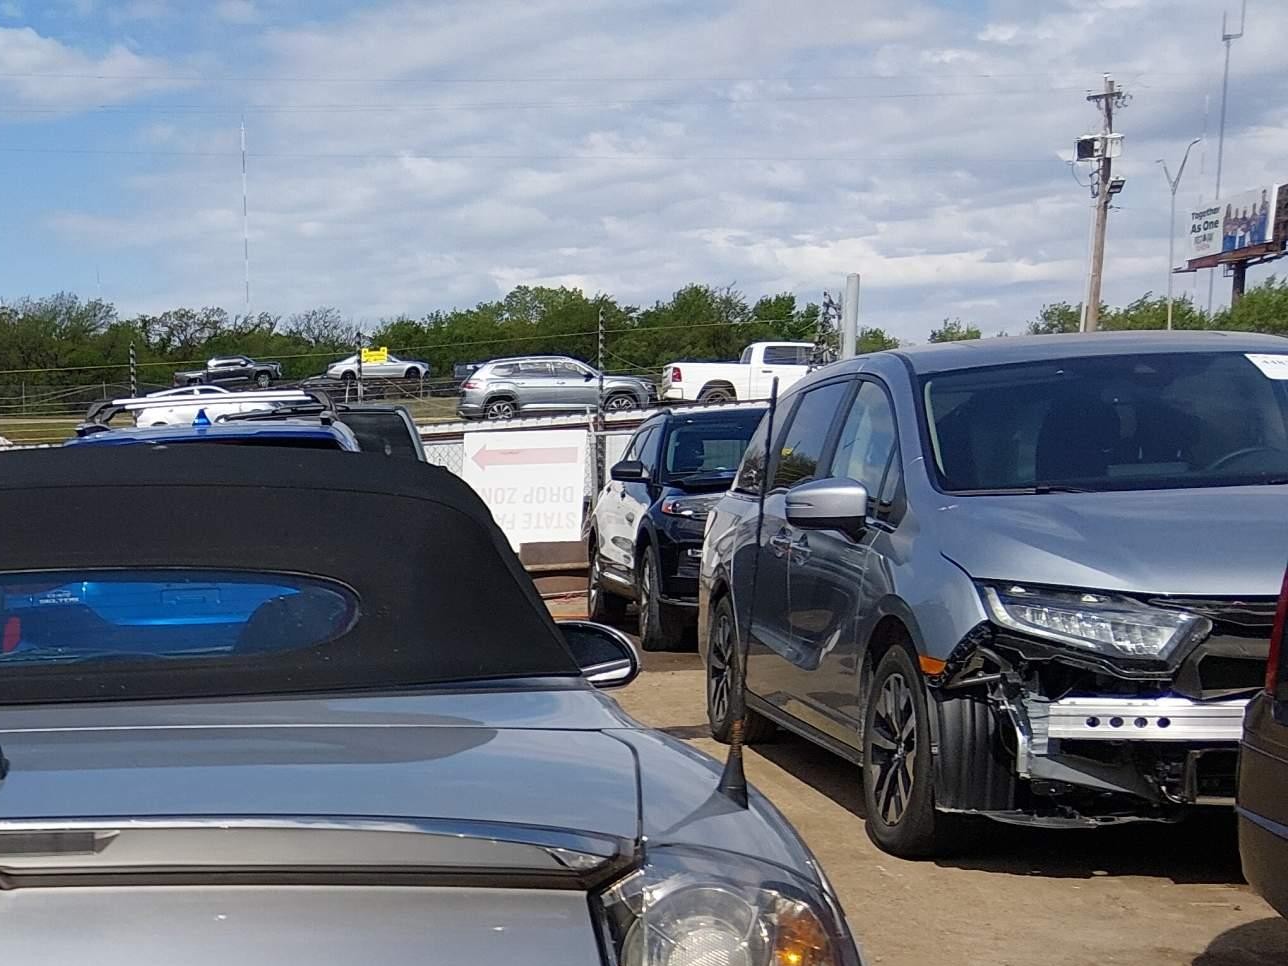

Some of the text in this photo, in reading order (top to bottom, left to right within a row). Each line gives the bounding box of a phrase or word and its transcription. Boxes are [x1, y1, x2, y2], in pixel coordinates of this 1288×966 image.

[1190, 219, 1220, 234] As One
[480, 486, 575, 505] DROP ZON
[495, 511, 577, 531] STATE FA
